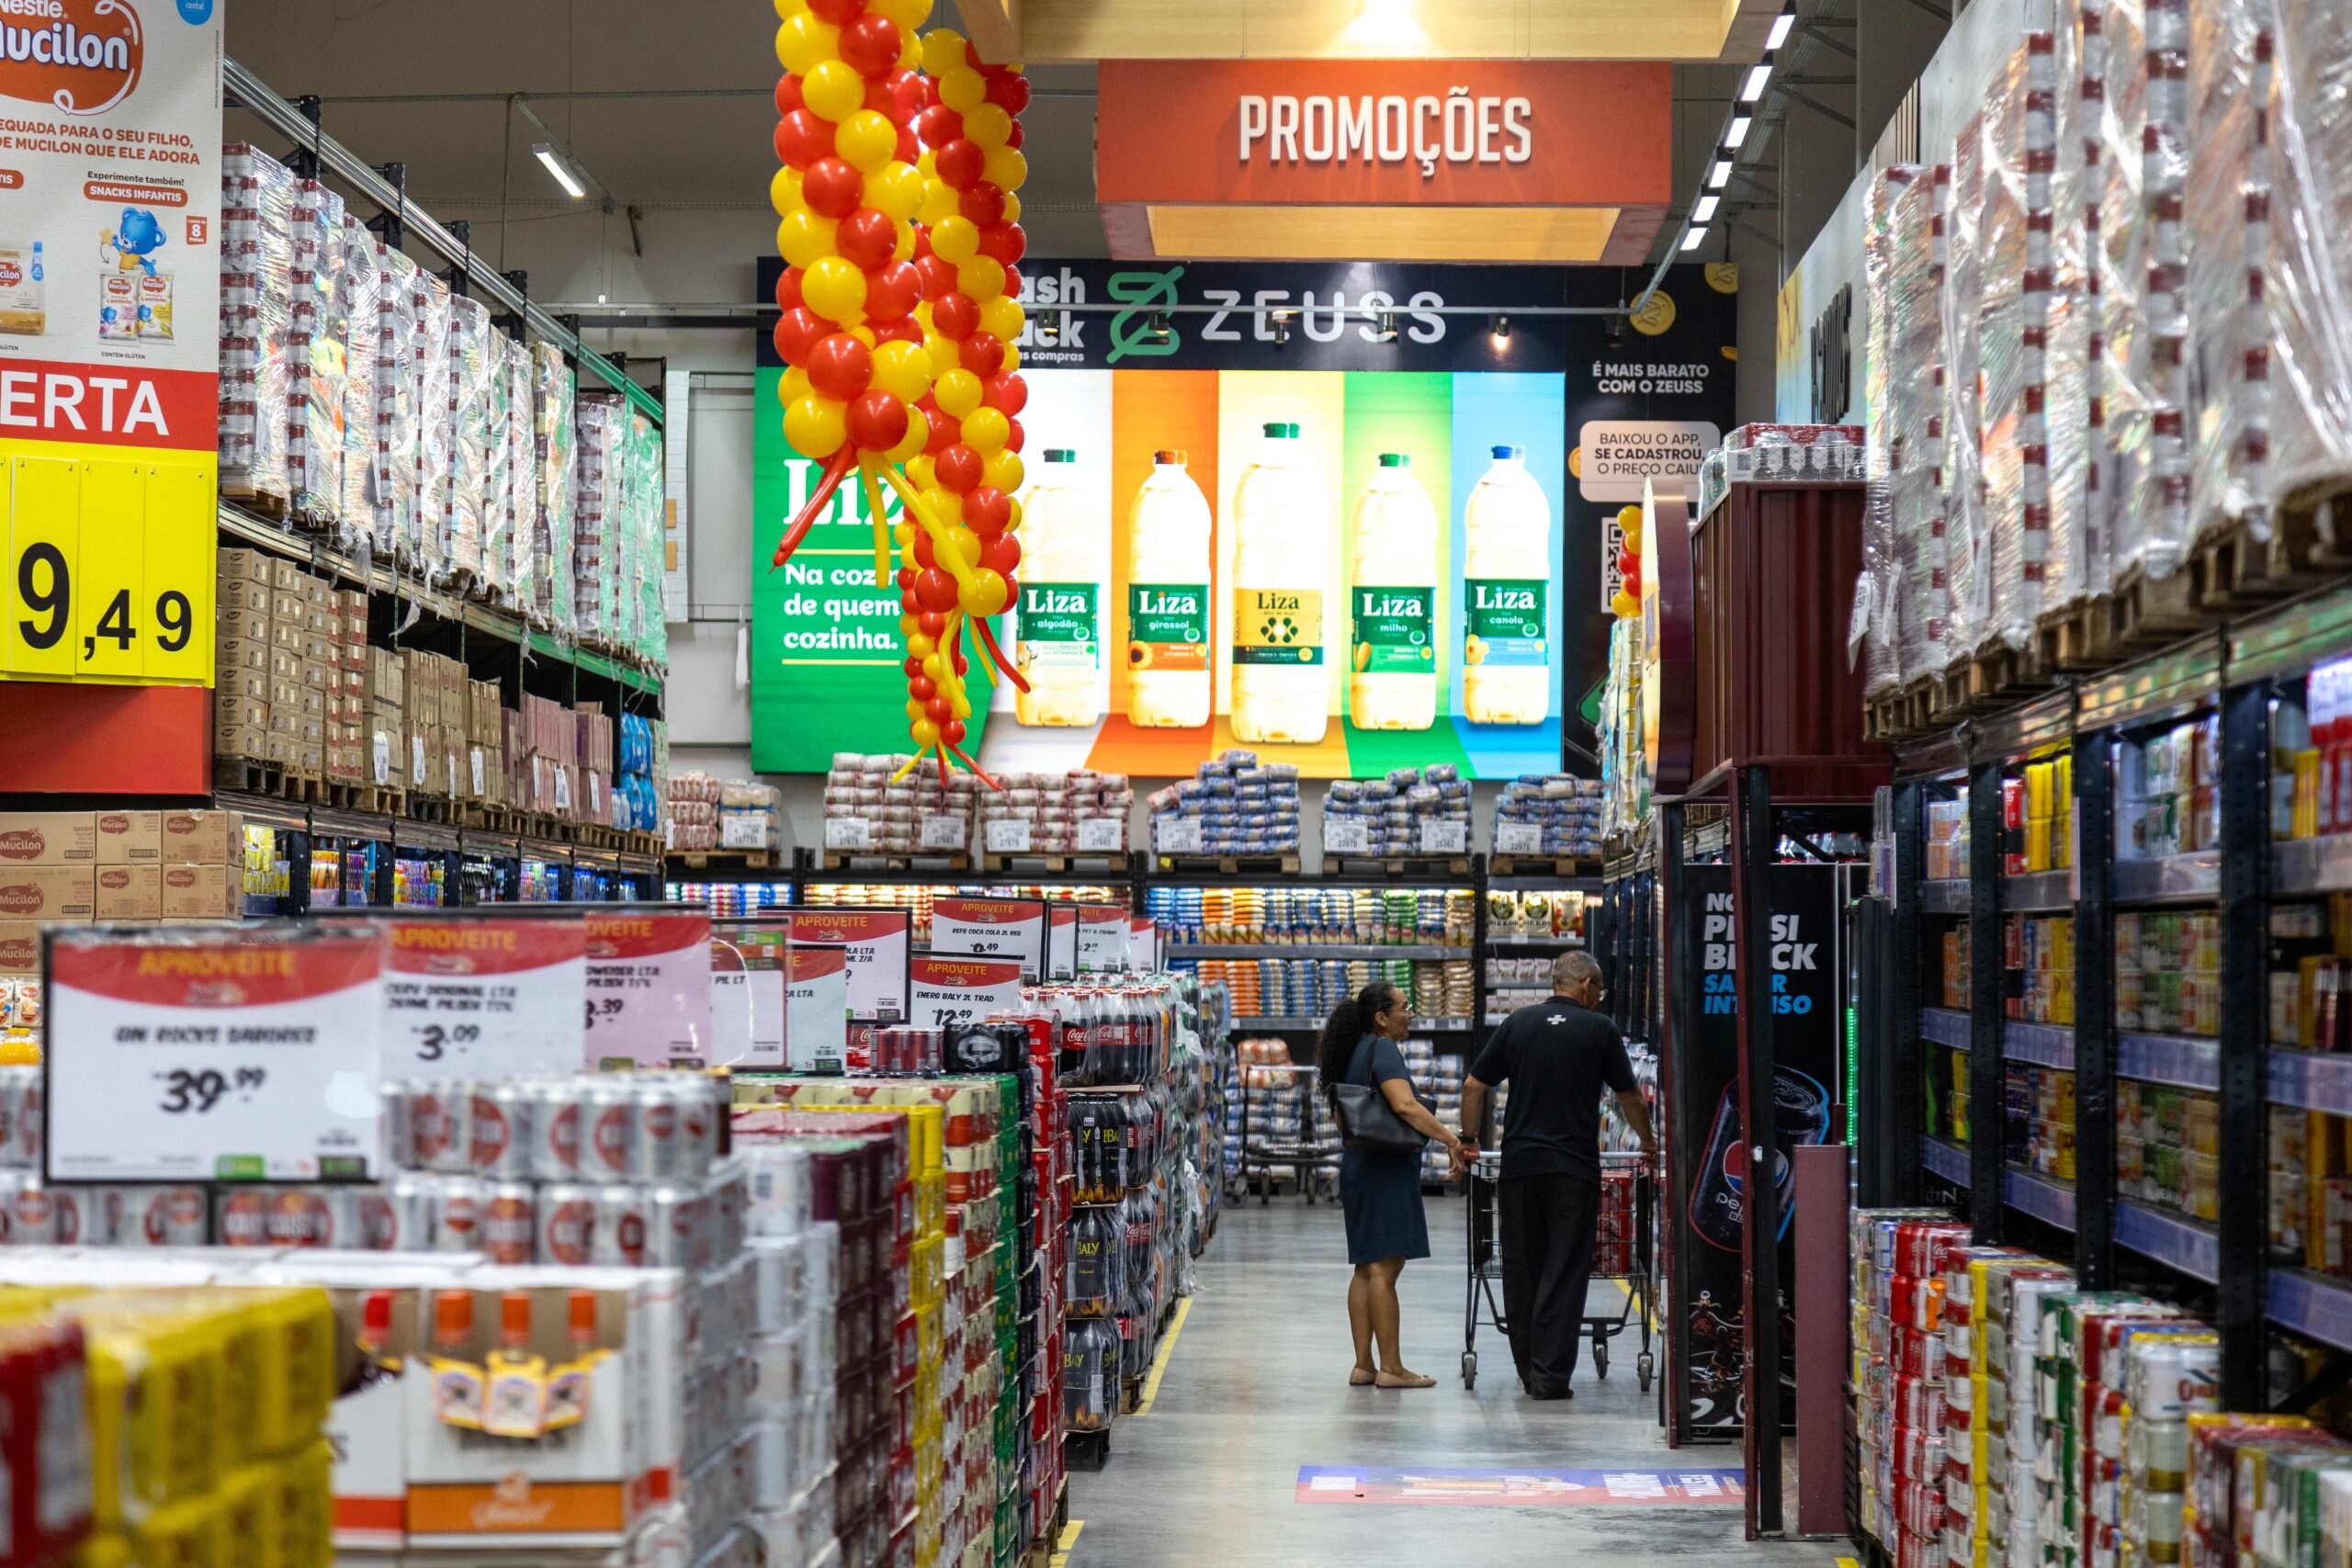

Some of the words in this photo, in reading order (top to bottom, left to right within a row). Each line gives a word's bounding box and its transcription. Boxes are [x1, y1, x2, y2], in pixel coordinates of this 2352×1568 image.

[60, 125, 98, 139] PARA
[102, 129, 113, 140] O
[117, 129, 144, 143] SEU
[147, 132, 194, 149] FILHO,
[1239, 85, 1532, 177] PROMOÇÕES
[16, 138, 82, 154] MUCILON
[85, 143, 115, 158] QUE
[119, 145, 145, 160] ELE
[148, 150, 200, 164] ADORA
[87, 171, 144, 184] Experimente
[145, 175, 185, 186] também!
[89, 186, 132, 198] SNACKS
[134, 189, 182, 202] INFANTIS
[192, 223, 201, 237] 8
[1016, 266, 1086, 304] ash
[1201, 290, 1446, 344] ZEUSS
[1014, 310, 1086, 348] ack
[1031, 351, 1085, 363] compras
[1592, 360, 1601, 377] É
[1605, 364, 1644, 377] MAIS
[1646, 364, 1709, 378] BARATO
[1598, 379, 1635, 393] COM
[1639, 379, 1653, 393] O
[1656, 379, 1703, 393] ZEUSS
[0, 370, 170, 436] ERTA
[1600, 433, 1654, 445] BAIXOU
[1656, 433, 1668, 445] O
[1671, 433, 1701, 447] APP,
[1595, 448, 1617, 459] SE
[1620, 448, 1705, 461] CADASTROU,
[1597, 463, 1610, 475] O
[1612, 463, 1661, 478] PREÇO
[783, 458, 906, 525] Liz
[785, 563, 823, 585] Na
[1026, 589, 1088, 614] Liza
[1138, 591, 1198, 615] Liza
[1257, 592, 1300, 610] Liza
[1363, 592, 1423, 617] Liza
[1476, 585, 1537, 610] Liza
[784, 592, 818, 615] de
[823, 599, 900, 622] quem
[1037, 618, 1079, 629] algodão
[1148, 619, 1190, 631] girassol
[1380, 623, 1408, 632] milho
[1489, 615, 1524, 625] canola
[783, 626, 899, 649] cozinha.
[101, 820, 128, 829] Mucilon
[168, 821, 194, 829] Mucilon
[0, 840, 41, 852] Mucilon
[101, 874, 128, 884] Mucilon
[167, 874, 194, 883] Mucilon
[0, 894, 40, 906] Mucilon
[961, 902, 1014, 913] APROVEITE
[1080, 908, 1101, 916] VEITE
[586, 919, 653, 938] OVEITE
[796, 916, 868, 927] APROVEITE
[1703, 914, 1800, 942] PSI
[393, 928, 517, 952] APROVEITE
[860, 947, 875, 955] LTA
[1703, 943, 1819, 971] BCK
[138, 949, 296, 977] APROVEITE
[586, 965, 635, 976] DWEISER
[926, 963, 988, 976] APROVEITE
[1703, 974, 1788, 993] SAR
[916, 991, 940, 999] ENERG
[943, 992, 962, 1000] BALY
[974, 994, 995, 1002] TRAD
[1703, 995, 1813, 1015] INSO
[1077, 1241, 1100, 1256] BALY
